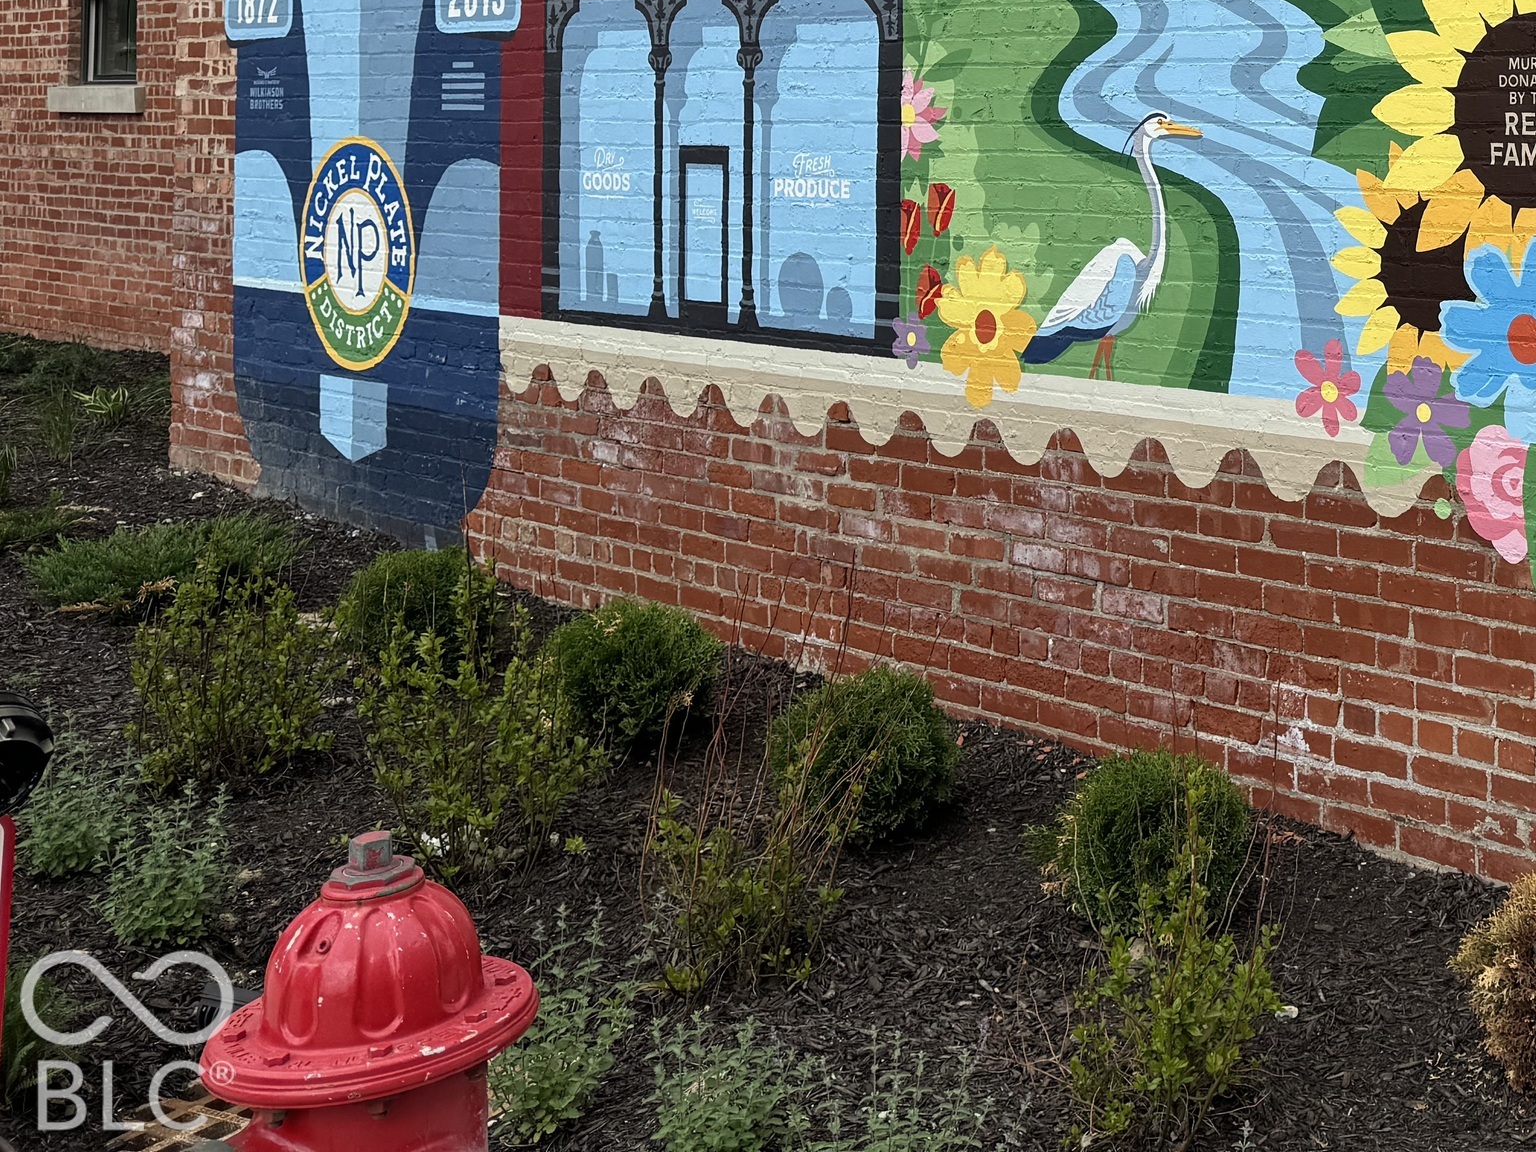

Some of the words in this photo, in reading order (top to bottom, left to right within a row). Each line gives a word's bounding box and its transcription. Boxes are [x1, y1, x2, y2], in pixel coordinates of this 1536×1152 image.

[249, 87, 285, 98] WILKINSON
[1509, 91, 1525, 105] BY
[249, 99, 284, 110] BROTHERS
[582, 173, 631, 192] GOODS
[774, 178, 851, 200] PRODUCE
[304, 155, 361, 262] NICKEL
[362, 152, 407, 267] PLATE
[691, 208, 718, 217] WELCOME
[336, 206, 380, 298] NP
[319, 299, 395, 349] DISTRICT
